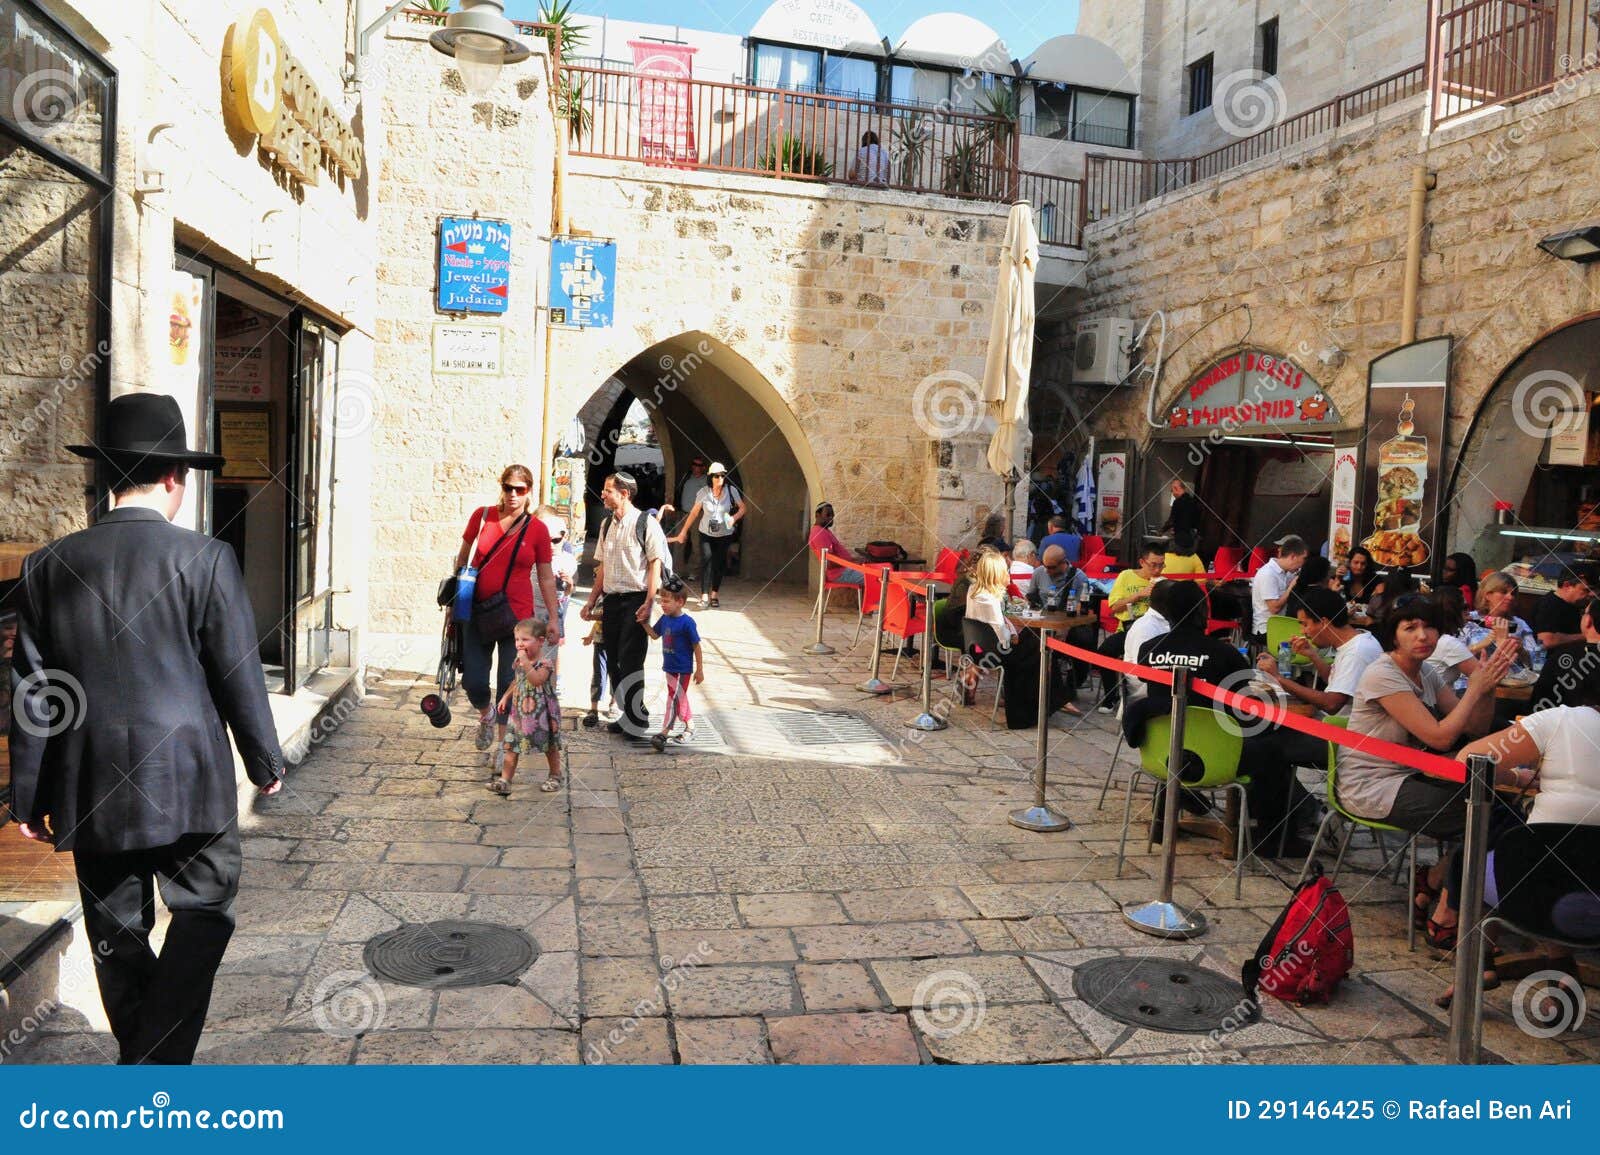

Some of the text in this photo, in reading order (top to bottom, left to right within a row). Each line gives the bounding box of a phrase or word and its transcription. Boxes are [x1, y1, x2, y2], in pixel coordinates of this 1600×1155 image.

[254, 27, 277, 113] B
[486, 225, 510, 252] בית
[445, 271, 507, 287] Jewellry
[469, 283, 484, 294] &
[447, 292, 503, 306] Judaica
[1149, 651, 1210, 667] Lokmar
